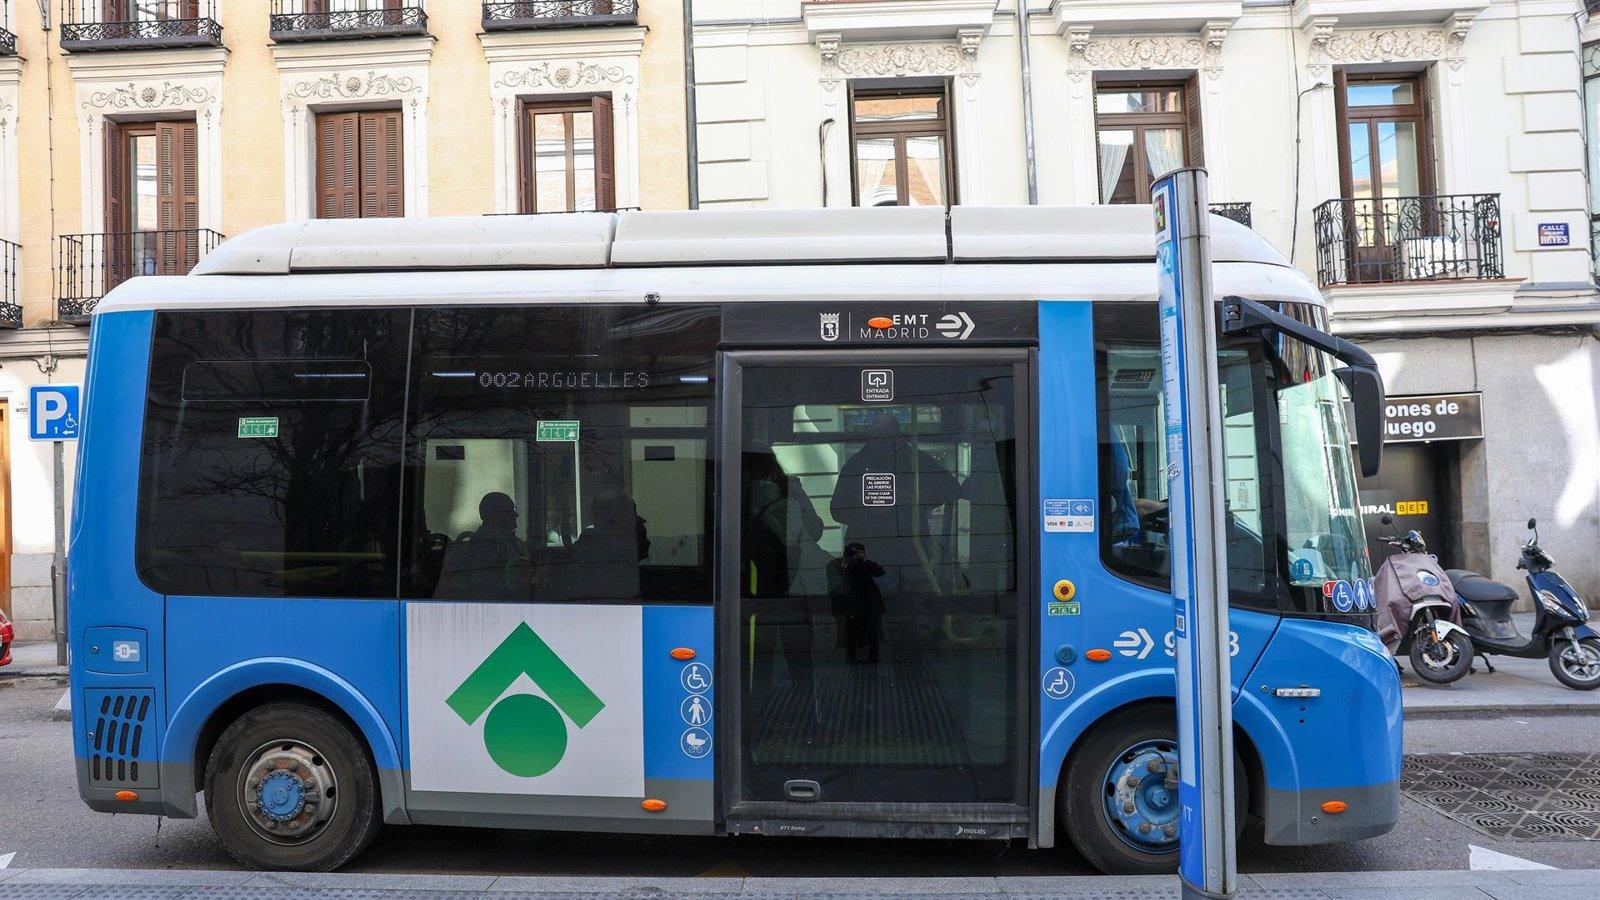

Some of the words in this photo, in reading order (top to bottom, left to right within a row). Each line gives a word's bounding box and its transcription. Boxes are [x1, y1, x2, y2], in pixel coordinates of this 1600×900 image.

[1540, 235, 1568, 244] REYES
[892, 314, 929, 325] EMT
[860, 328, 929, 339] MADRID
[36, 392, 68, 434] P
[1435, 400, 1459, 415] de
[54, 426, 58, 434] 1
[1397, 502, 1427, 514] BET
[963, 827, 987, 835] masats
